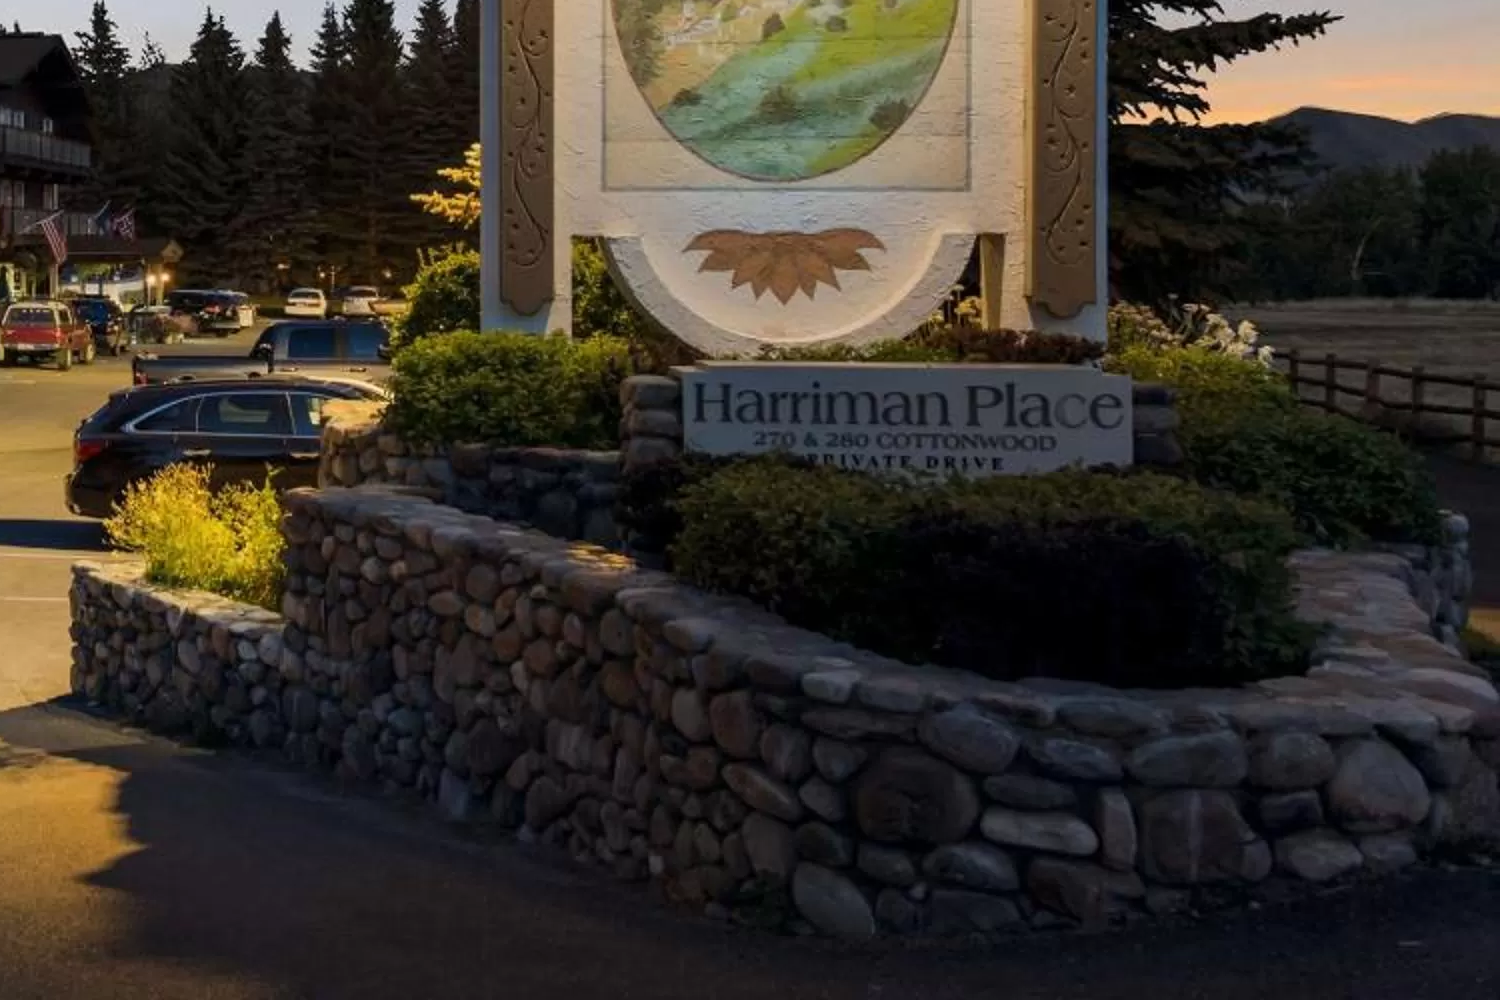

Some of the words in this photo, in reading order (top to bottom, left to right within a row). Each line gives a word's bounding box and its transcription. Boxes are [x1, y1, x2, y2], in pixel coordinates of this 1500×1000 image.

[693, 380, 951, 428] Harriman
[963, 383, 1125, 430] Place
[753, 431, 794, 448] 270
[803, 431, 818, 448] &
[825, 431, 868, 449] 280
[875, 432, 1057, 452] COTTONWOOD
[925, 455, 1004, 471] DRIVE
